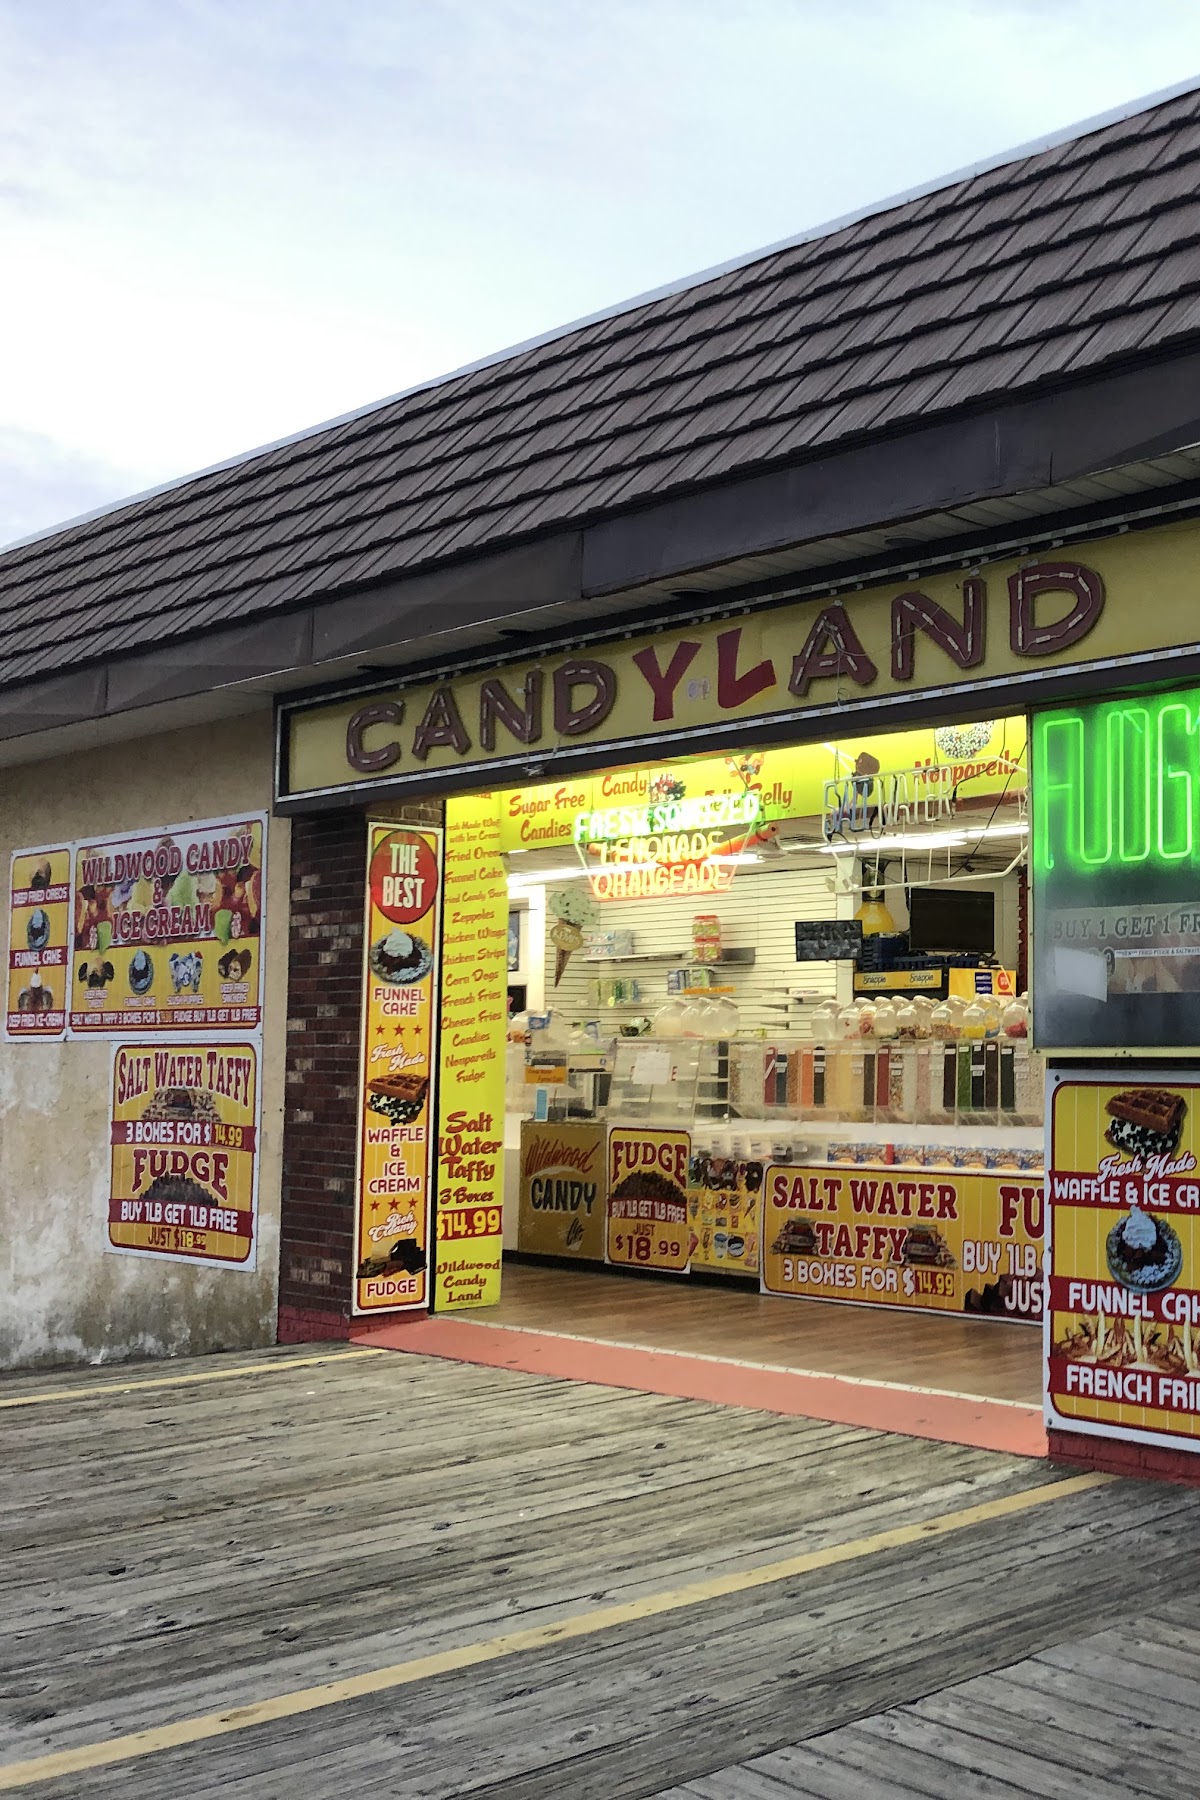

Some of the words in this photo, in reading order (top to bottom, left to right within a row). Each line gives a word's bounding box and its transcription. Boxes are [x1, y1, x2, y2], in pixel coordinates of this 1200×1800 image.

[346, 562, 1106, 772] CANDYLAND
[508, 795, 551, 817] Sugar
[554, 787, 585, 809] Free
[520, 819, 572, 842] Candies
[389, 843, 420, 875] THE
[599, 830, 724, 866] LEMONADE
[82, 846, 182, 886] WILDWOOD
[186, 834, 255, 874] CANDY
[443, 870, 477, 884] Funnel
[479, 867, 504, 880] Cake
[593, 863, 731, 898] ORANGEADE
[152, 878, 164, 905] &
[382, 876, 425, 909] BEST
[111, 909, 143, 941] ICE
[145, 903, 212, 938] CREAM
[452, 908, 495, 924] Zeppoles
[442, 932, 475, 946] Chicken
[477, 926, 507, 940] Wings
[15, 951, 42, 967] FUNNEL
[43, 949, 62, 964] CAKE
[441, 952, 476, 966] Chicken
[477, 946, 506, 961] Strips
[445, 973, 470, 987] Corn
[471, 969, 499, 983] Dogs
[374, 987, 425, 1002] FUNNEL
[441, 993, 476, 1007] French
[477, 988, 502, 1001] Fries
[382, 1001, 418, 1016] CAKE
[440, 1016, 476, 1030] Cheese
[477, 1010, 502, 1023] Fries
[452, 1032, 490, 1047] Candies
[118, 1052, 151, 1105] SALT
[154, 1052, 203, 1089] WATER
[206, 1052, 251, 1107] TAFFY
[456, 1068, 486, 1083] Fudge
[446, 1111, 493, 1134] Salt
[368, 1127, 424, 1143] WAFFLE
[438, 1134, 503, 1157] Water
[390, 1144, 401, 1157] &
[132, 1149, 229, 1201] FUDGE
[384, 1162, 406, 1177] ICE
[440, 1156, 496, 1182] Taffy
[612, 1141, 687, 1190] FUDGE
[1098, 1154, 1144, 1183] Fresh
[1143, 1151, 1197, 1182] Made
[369, 1178, 420, 1194] CREAM
[440, 1187, 451, 1205] 3
[452, 1187, 494, 1204] Boxes
[531, 1178, 596, 1216] CANDY
[773, 1175, 842, 1211] SALT
[849, 1180, 958, 1219] WATER
[1054, 1177, 1121, 1204] WAFFLE
[1125, 1182, 1138, 1205] &
[1143, 1182, 1169, 1207] ICE
[612, 1201, 625, 1218] BUY
[625, 1201, 637, 1218] 1LB
[638, 1203, 652, 1219] GET
[653, 1203, 666, 1221] 1LB
[667, 1205, 686, 1224] FREE
[633, 1223, 656, 1236] JUST
[815, 1222, 908, 1263] TAFFY
[435, 1259, 500, 1276] Wildwood
[367, 1279, 417, 1298] FUDGE
[443, 1274, 487, 1289] Candy
[446, 1289, 482, 1304] Land
[1068, 1282, 1155, 1319] FUNNEL
[1066, 1364, 1152, 1404] FRENCH
